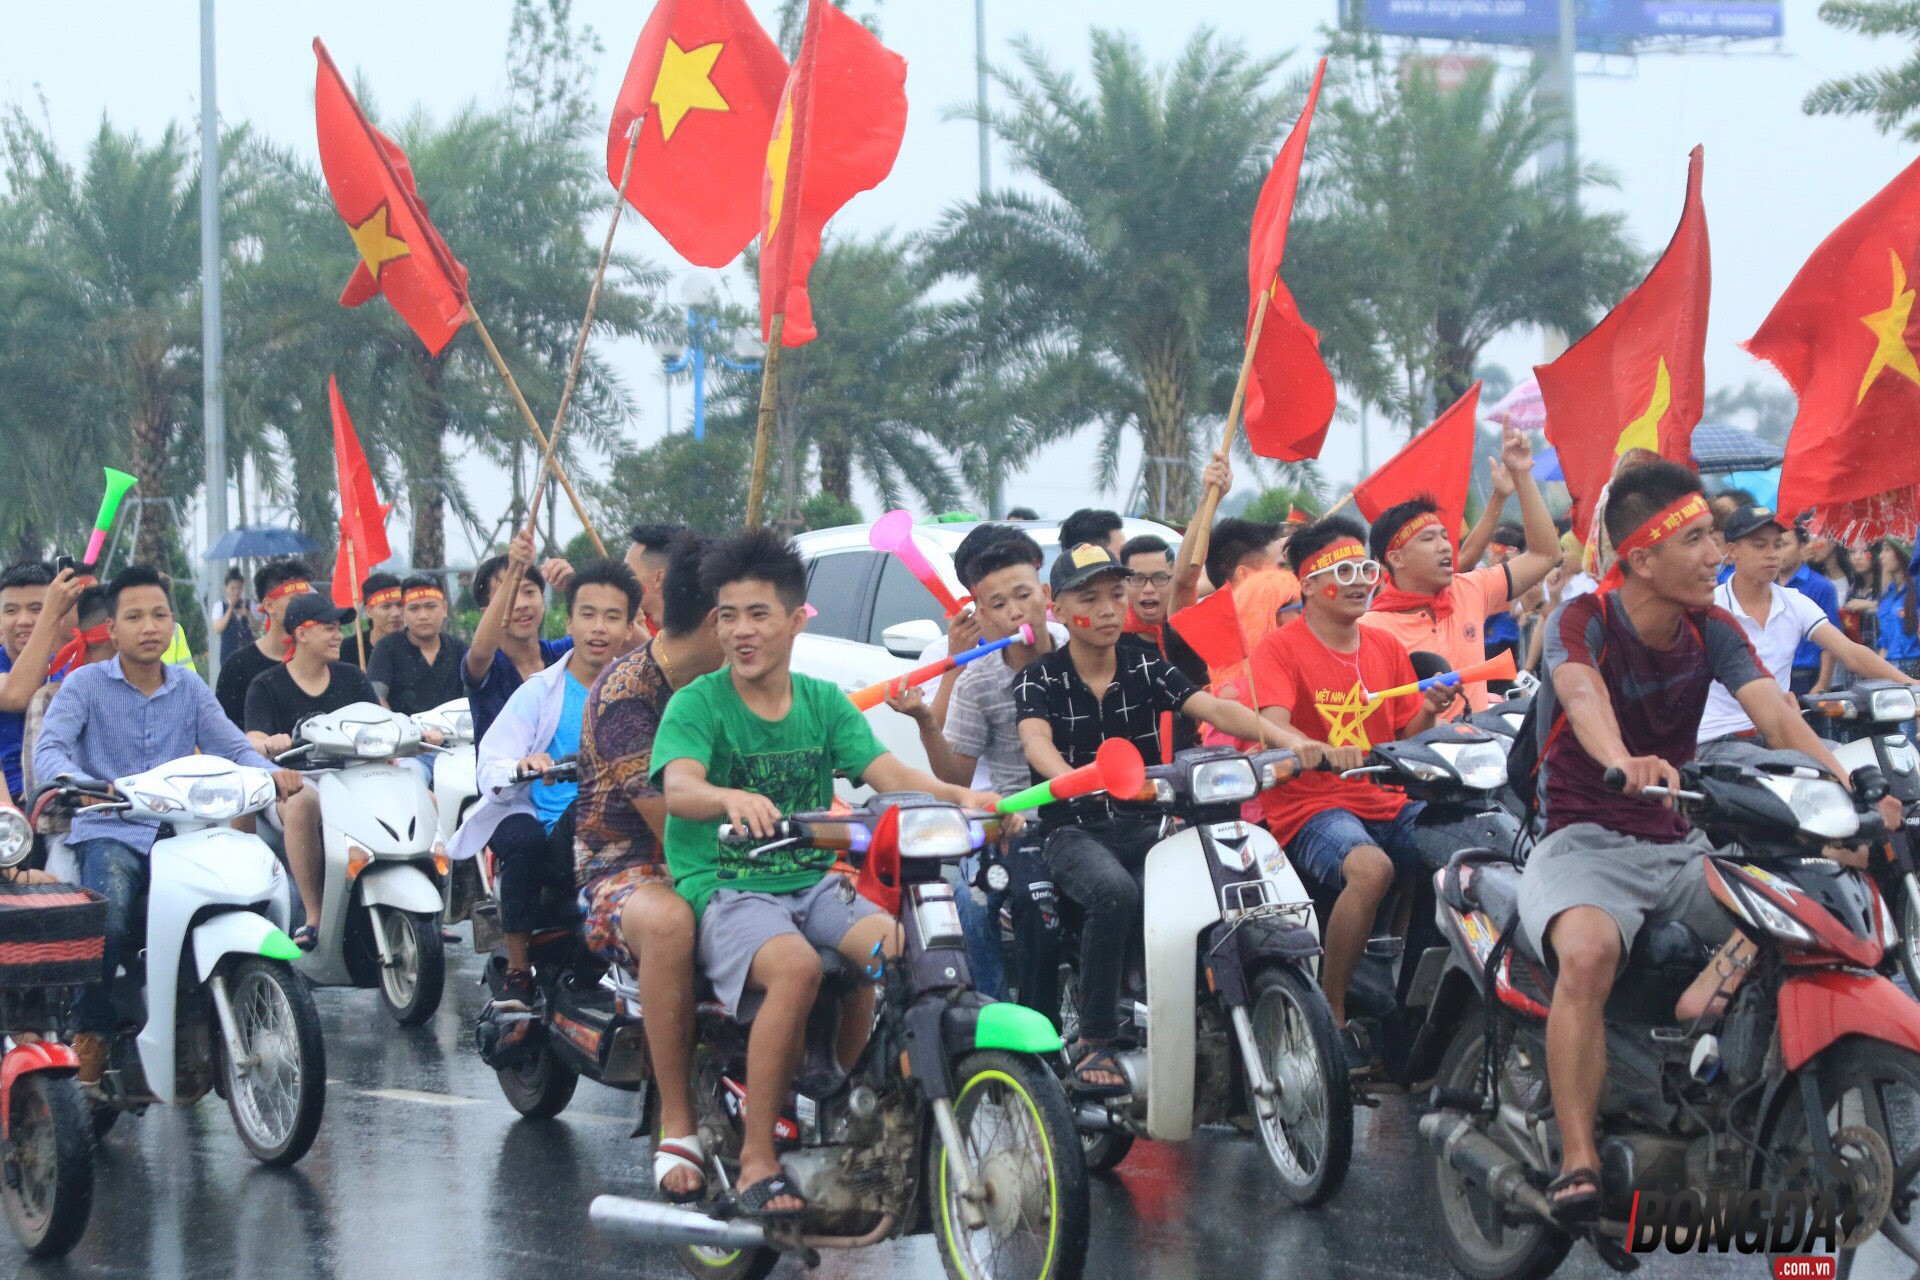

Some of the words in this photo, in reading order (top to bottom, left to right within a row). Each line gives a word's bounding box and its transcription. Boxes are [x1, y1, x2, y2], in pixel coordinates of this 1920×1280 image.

[1316, 553, 1333, 569] VIỆT
[1332, 545, 1352, 561] NAM
[1800, 857, 1838, 866] HONDA
